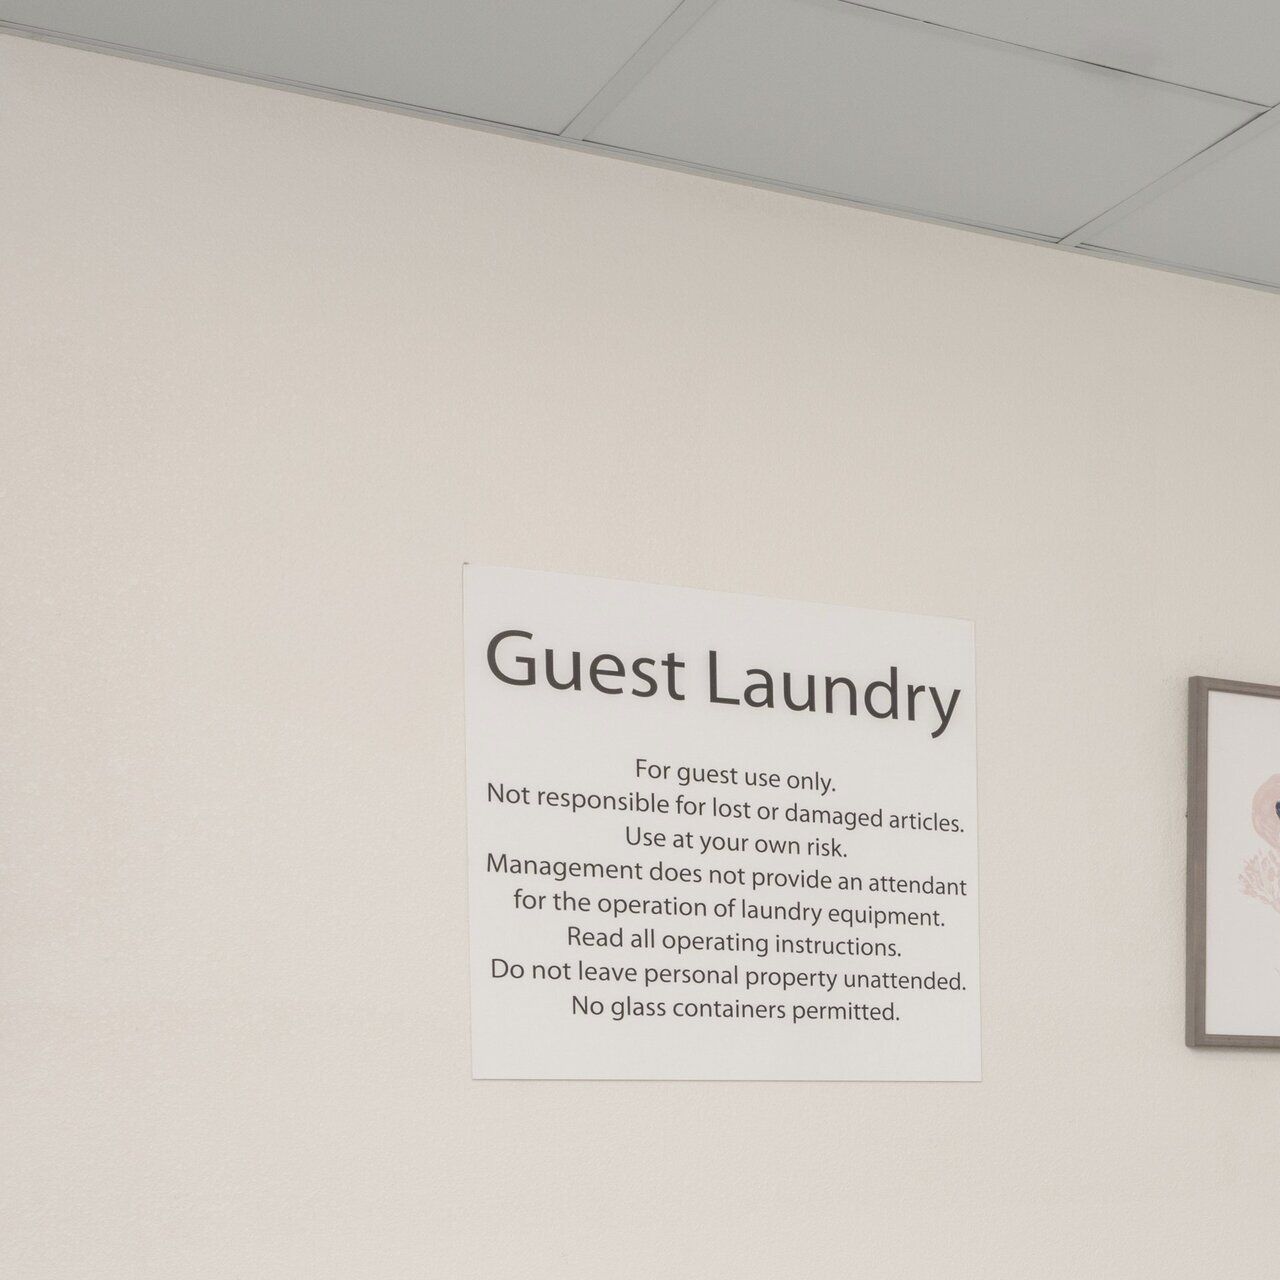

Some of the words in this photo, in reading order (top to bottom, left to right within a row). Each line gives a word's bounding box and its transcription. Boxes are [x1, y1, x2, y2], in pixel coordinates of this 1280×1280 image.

[486, 629, 686, 701] Guest
[708, 649, 962, 739] Laundry
[636, 758, 671, 780] For
[677, 766, 739, 787] guest
[744, 771, 781, 788] use
[786, 771, 836, 797] only.
[487, 782, 531, 805] Not
[537, 790, 670, 814] responsible
[675, 794, 707, 816] for
[712, 796, 752, 820] lost
[757, 805, 780, 821] or
[784, 802, 883, 831] damaged
[889, 812, 964, 833] articles.
[625, 825, 667, 848] Use
[672, 831, 694, 850] at
[699, 835, 750, 855] your
[754, 838, 801, 855] own
[807, 837, 848, 858] risk.
[487, 852, 643, 882] Management
[649, 860, 703, 883] does
[709, 868, 746, 886] not
[752, 869, 833, 891] provide
[837, 876, 863, 891] an
[868, 875, 968, 897] attendant
[513, 887, 547, 910] for
[552, 890, 591, 912] the
[597, 896, 707, 919] operation
[713, 897, 737, 918] of
[741, 898, 823, 927] laundry
[828, 905, 945, 929] equipment.
[567, 926, 623, 948] Read
[630, 928, 655, 949] all
[662, 932, 769, 958] operating
[775, 934, 902, 957] instructions.
[491, 958, 525, 979] Do
[532, 962, 572, 981] not
[578, 959, 638, 983] leave
[644, 964, 738, 988] personal
[745, 970, 838, 993] property
[844, 970, 966, 991] unattended.
[572, 995, 605, 1016] No
[610, 995, 667, 1022] glass
[672, 999, 786, 1019] containers
[792, 1001, 900, 1024] permitted.
